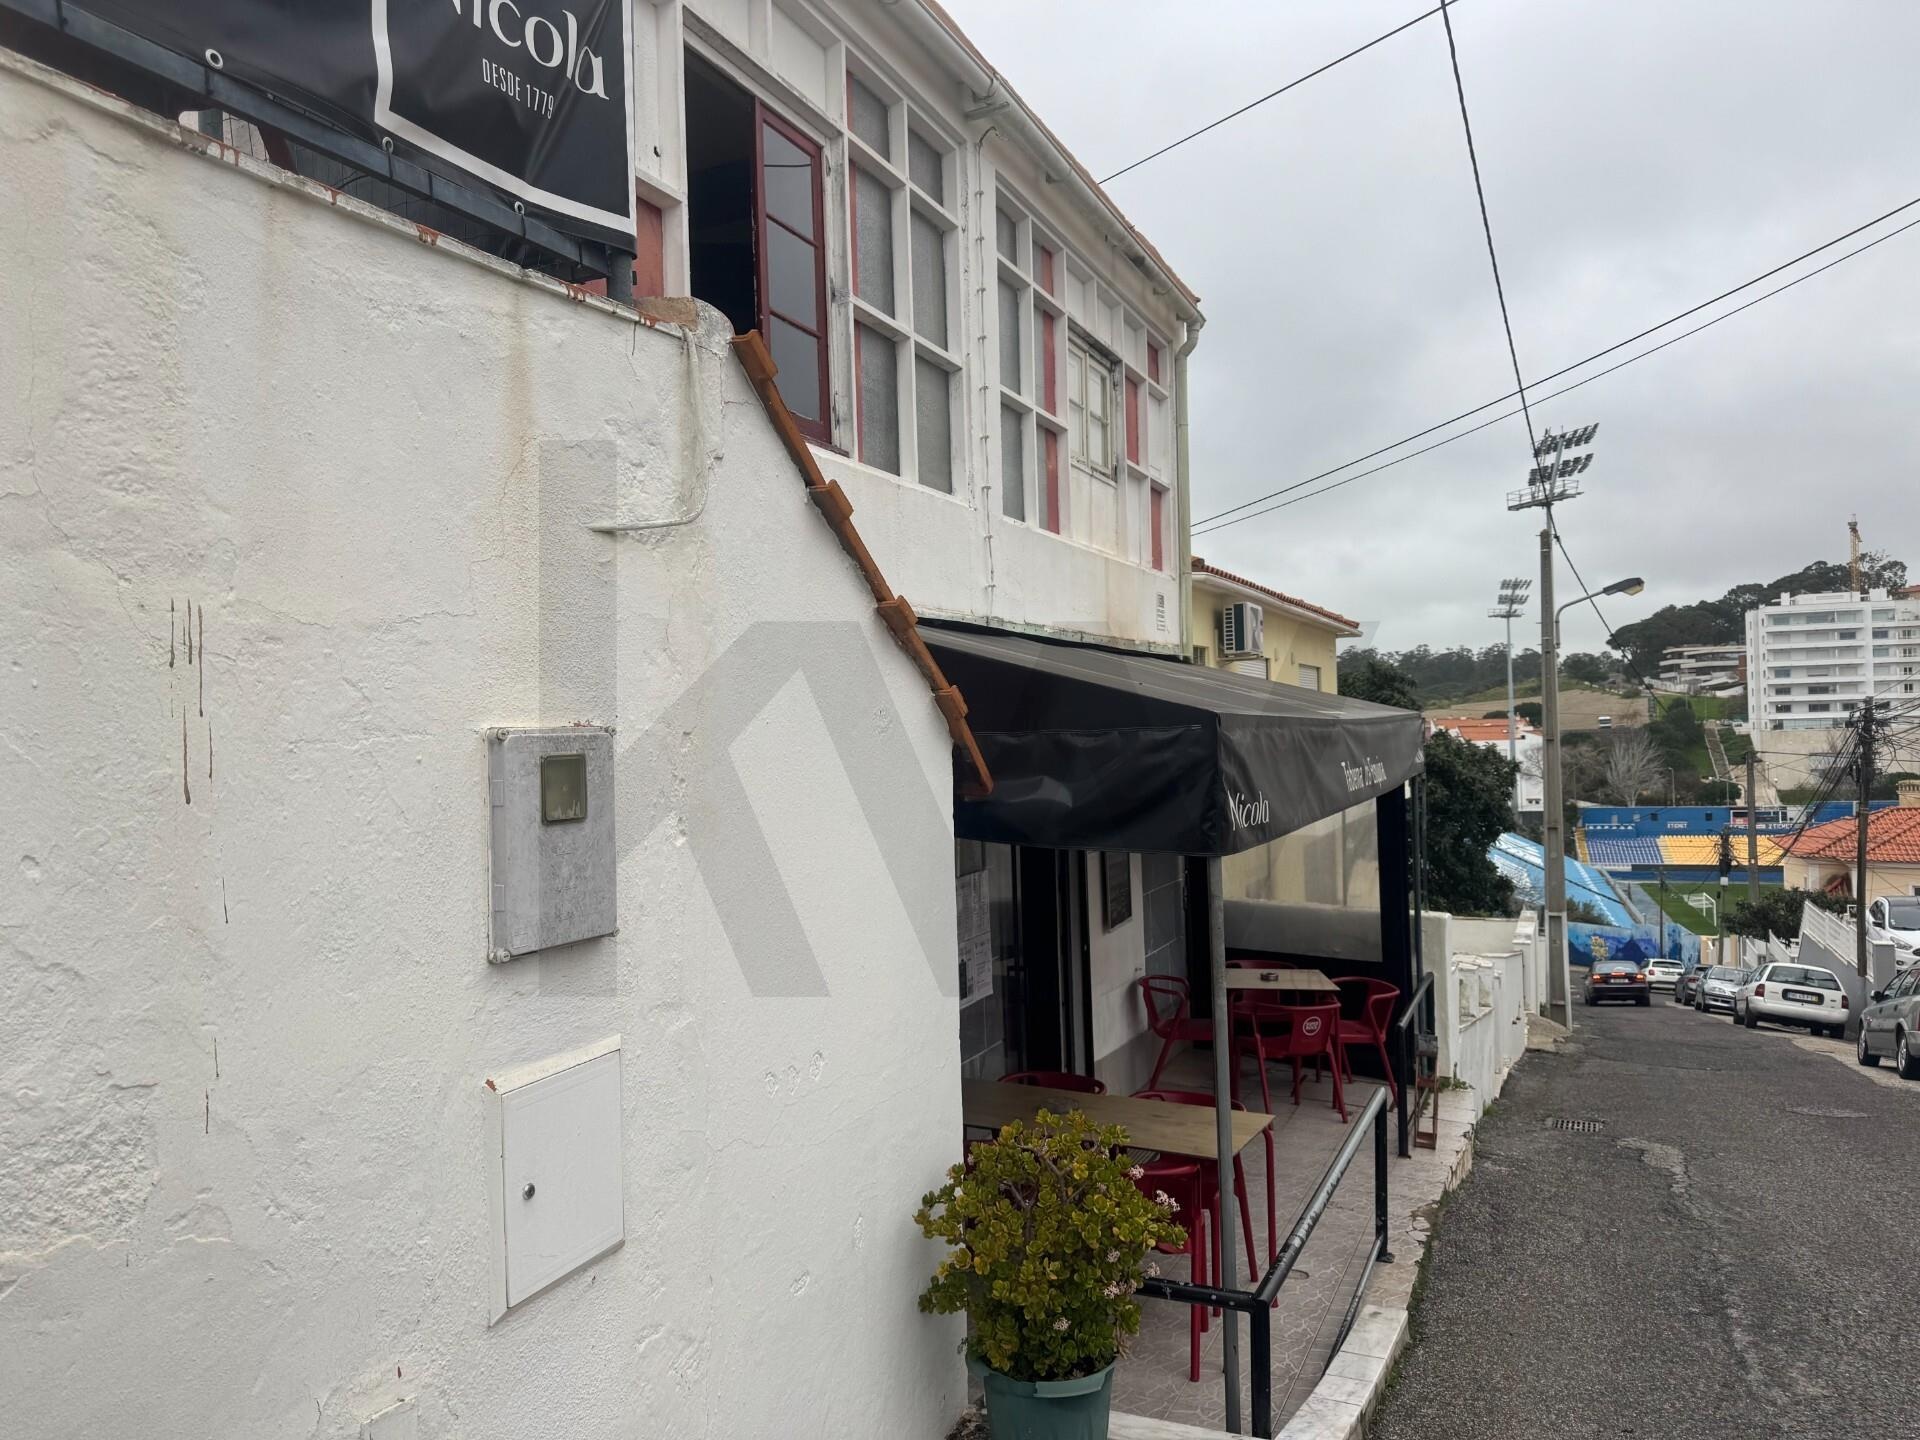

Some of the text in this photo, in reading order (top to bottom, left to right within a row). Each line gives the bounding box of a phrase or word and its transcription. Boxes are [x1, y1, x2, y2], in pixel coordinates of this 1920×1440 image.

[481, 57, 555, 120] DESDE 1779
[1227, 789, 1270, 832] Nicola
